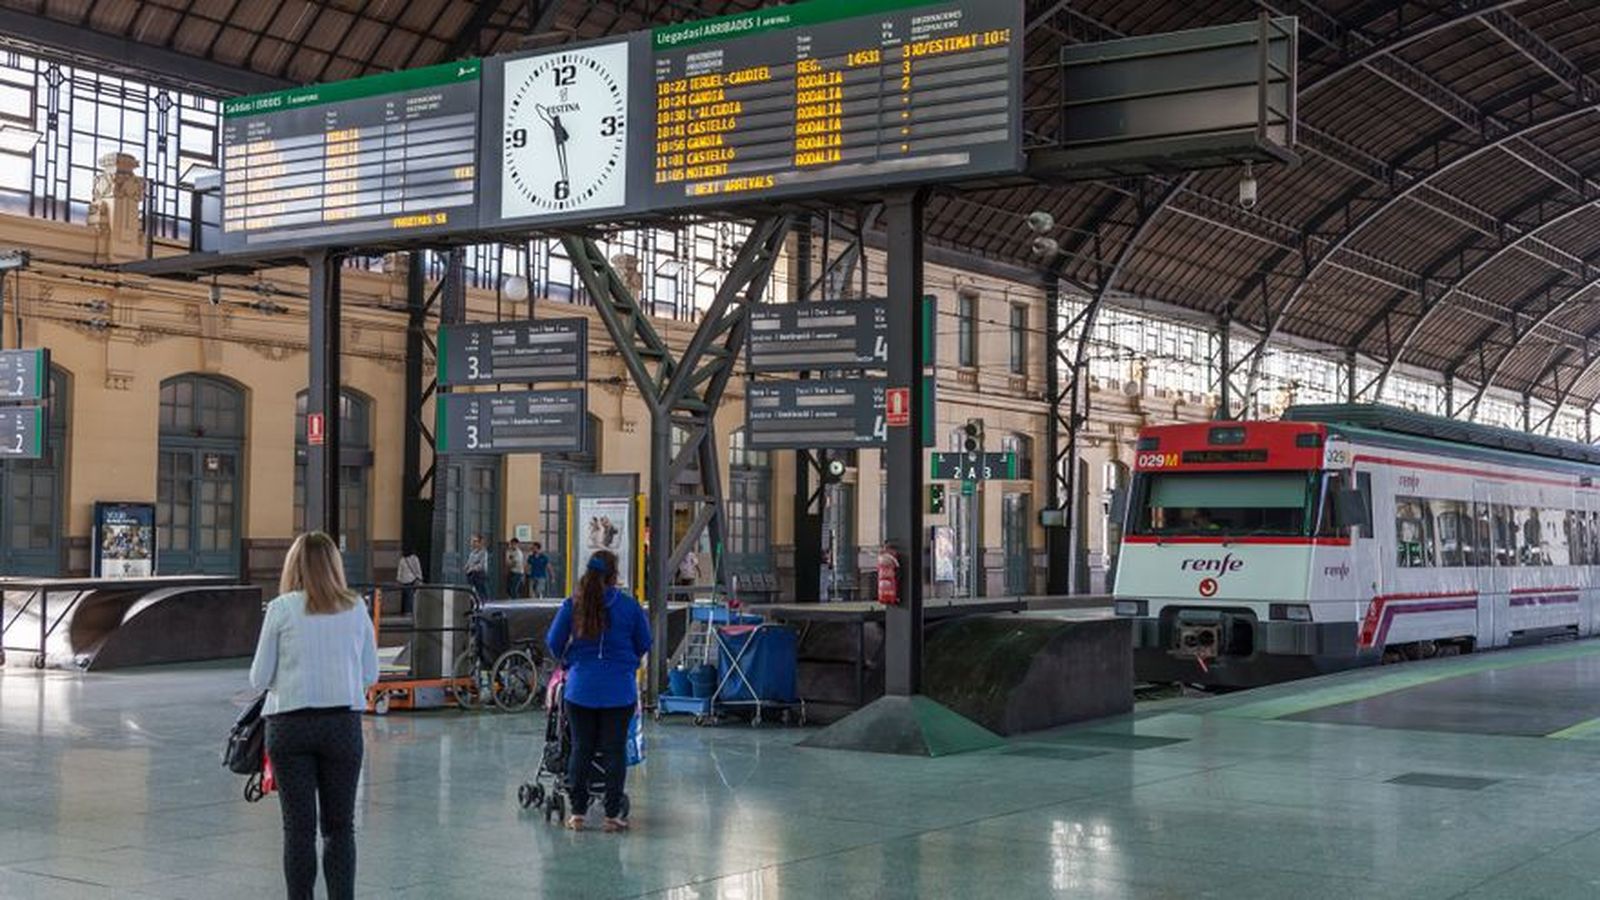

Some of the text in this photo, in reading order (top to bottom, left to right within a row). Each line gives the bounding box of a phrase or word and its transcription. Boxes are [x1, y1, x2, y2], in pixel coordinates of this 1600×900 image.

[704, 18, 754, 36] ARRIBADES
[902, 45, 911, 58] 3
[552, 64, 577, 87] 12
[902, 60, 911, 73] 3
[901, 76, 911, 90] 2
[546, 101, 581, 116] FESTINA
[600, 115, 617, 137] 3
[512, 127, 528, 149] 9
[553, 180, 570, 201] 6
[874, 335, 889, 362] 4
[468, 356, 479, 379] 3
[16, 376, 24, 396] 2
[466, 425, 478, 449] 3
[873, 415, 887, 441] 4
[15, 433, 23, 453] 2
[953, 466, 992, 479] 2 A 3
[1180, 552, 1244, 578] renfe
[1324, 561, 1350, 581] renfe
